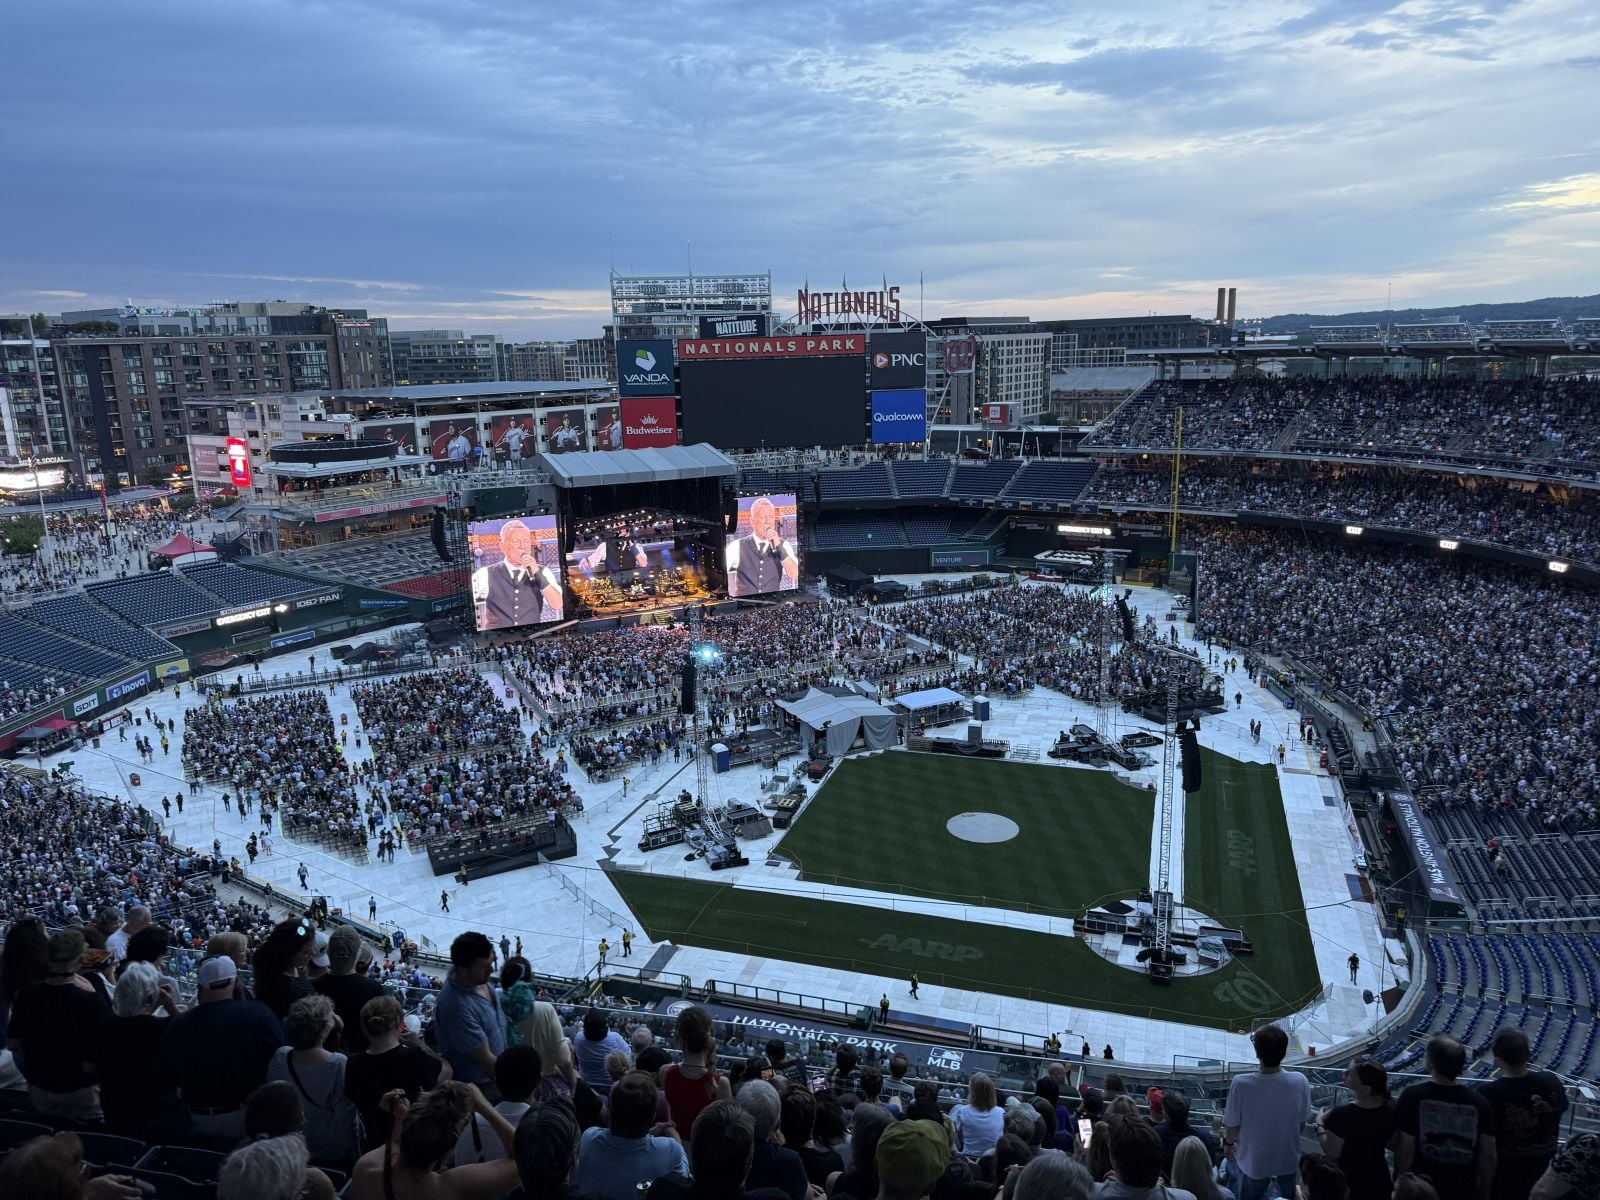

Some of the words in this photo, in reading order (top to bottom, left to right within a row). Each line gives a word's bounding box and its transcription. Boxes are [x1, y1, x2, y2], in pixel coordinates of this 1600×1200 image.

[798, 286, 900, 326] NATIONALS
[715, 319, 758, 335] NATITUDE
[685, 340, 797, 354] NATIONALS
[806, 338, 856, 351] PARK
[891, 353, 925, 366] PNC
[623, 373, 670, 383] VANDA
[874, 412, 924, 422] Qualcomm
[626, 426, 673, 435] Budweiser
[319, 593, 340, 604] FAN
[167, 627, 188, 637] Harris
[187, 622, 210, 633] Teeter
[121, 677, 146, 693] Inova
[75, 697, 97, 713] GDIT
[1398, 803, 1425, 837] NATIONALS
[1413, 837, 1447, 884] WASHINGTON
[859, 933, 985, 962] AARP
[732, 1015, 839, 1044] NATIONALS
[846, 1036, 898, 1054] PARK
[927, 1056, 961, 1071] MLB
